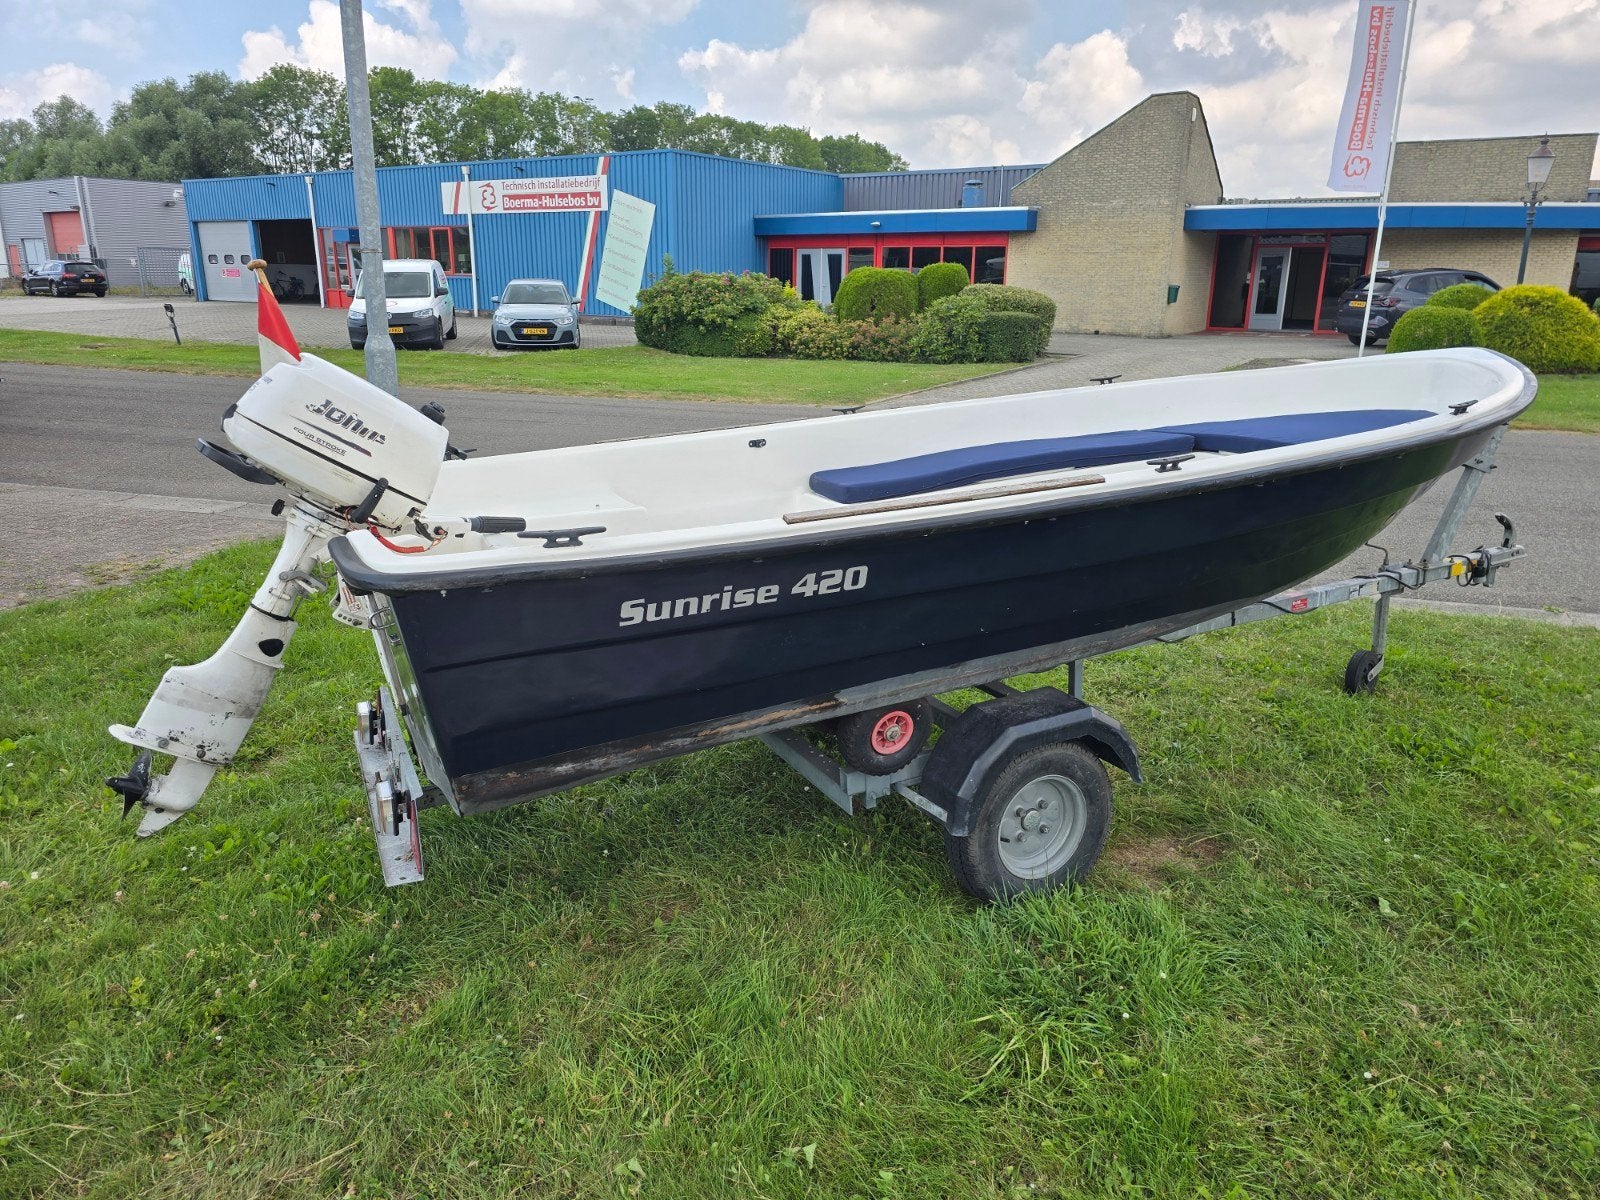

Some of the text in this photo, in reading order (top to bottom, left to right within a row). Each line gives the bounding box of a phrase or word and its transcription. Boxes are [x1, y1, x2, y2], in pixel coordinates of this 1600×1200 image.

[501, 177, 601, 191] Technisch installatiebedrijf
[503, 194, 586, 208] Boerma-Hulsebos
[587, 193, 600, 206] bv
[293, 426, 348, 456] FOUR STROKE
[618, 565, 869, 627] Sunrise 420
